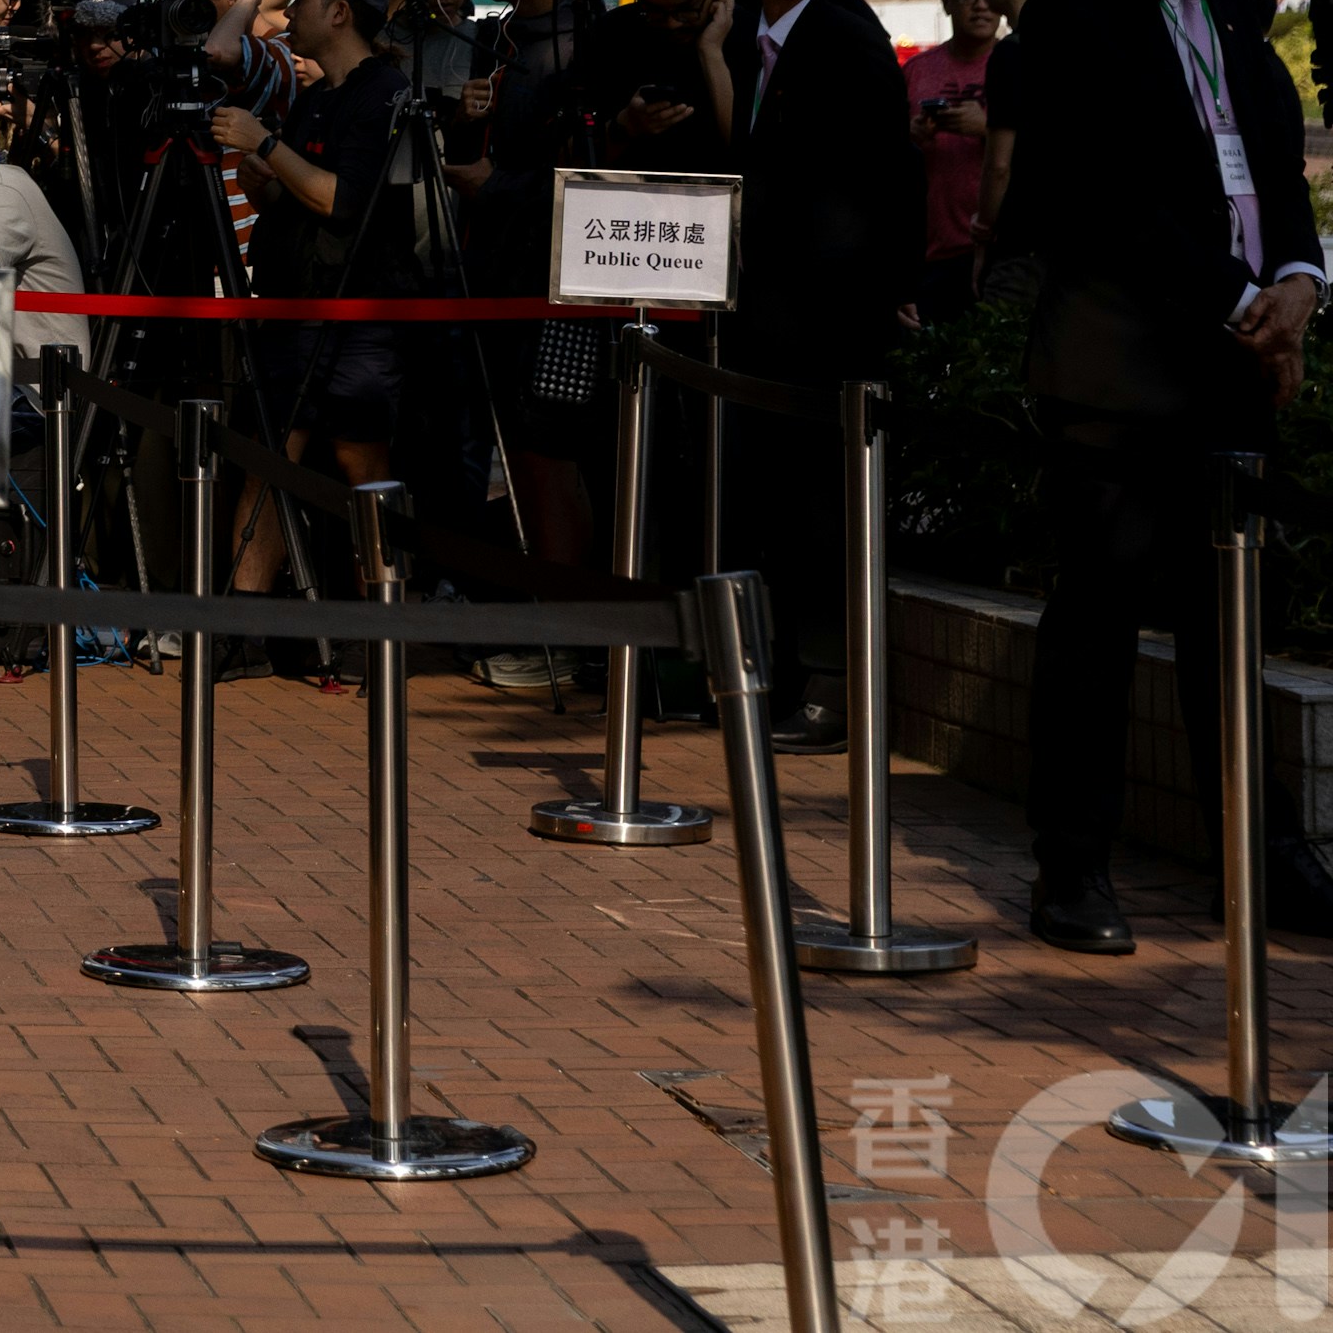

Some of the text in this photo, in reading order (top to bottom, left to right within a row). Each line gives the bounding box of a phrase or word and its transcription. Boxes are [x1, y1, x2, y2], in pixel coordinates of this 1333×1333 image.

[584, 218, 705, 245] 公眾排隊處
[584, 250, 704, 271] Public Queue
